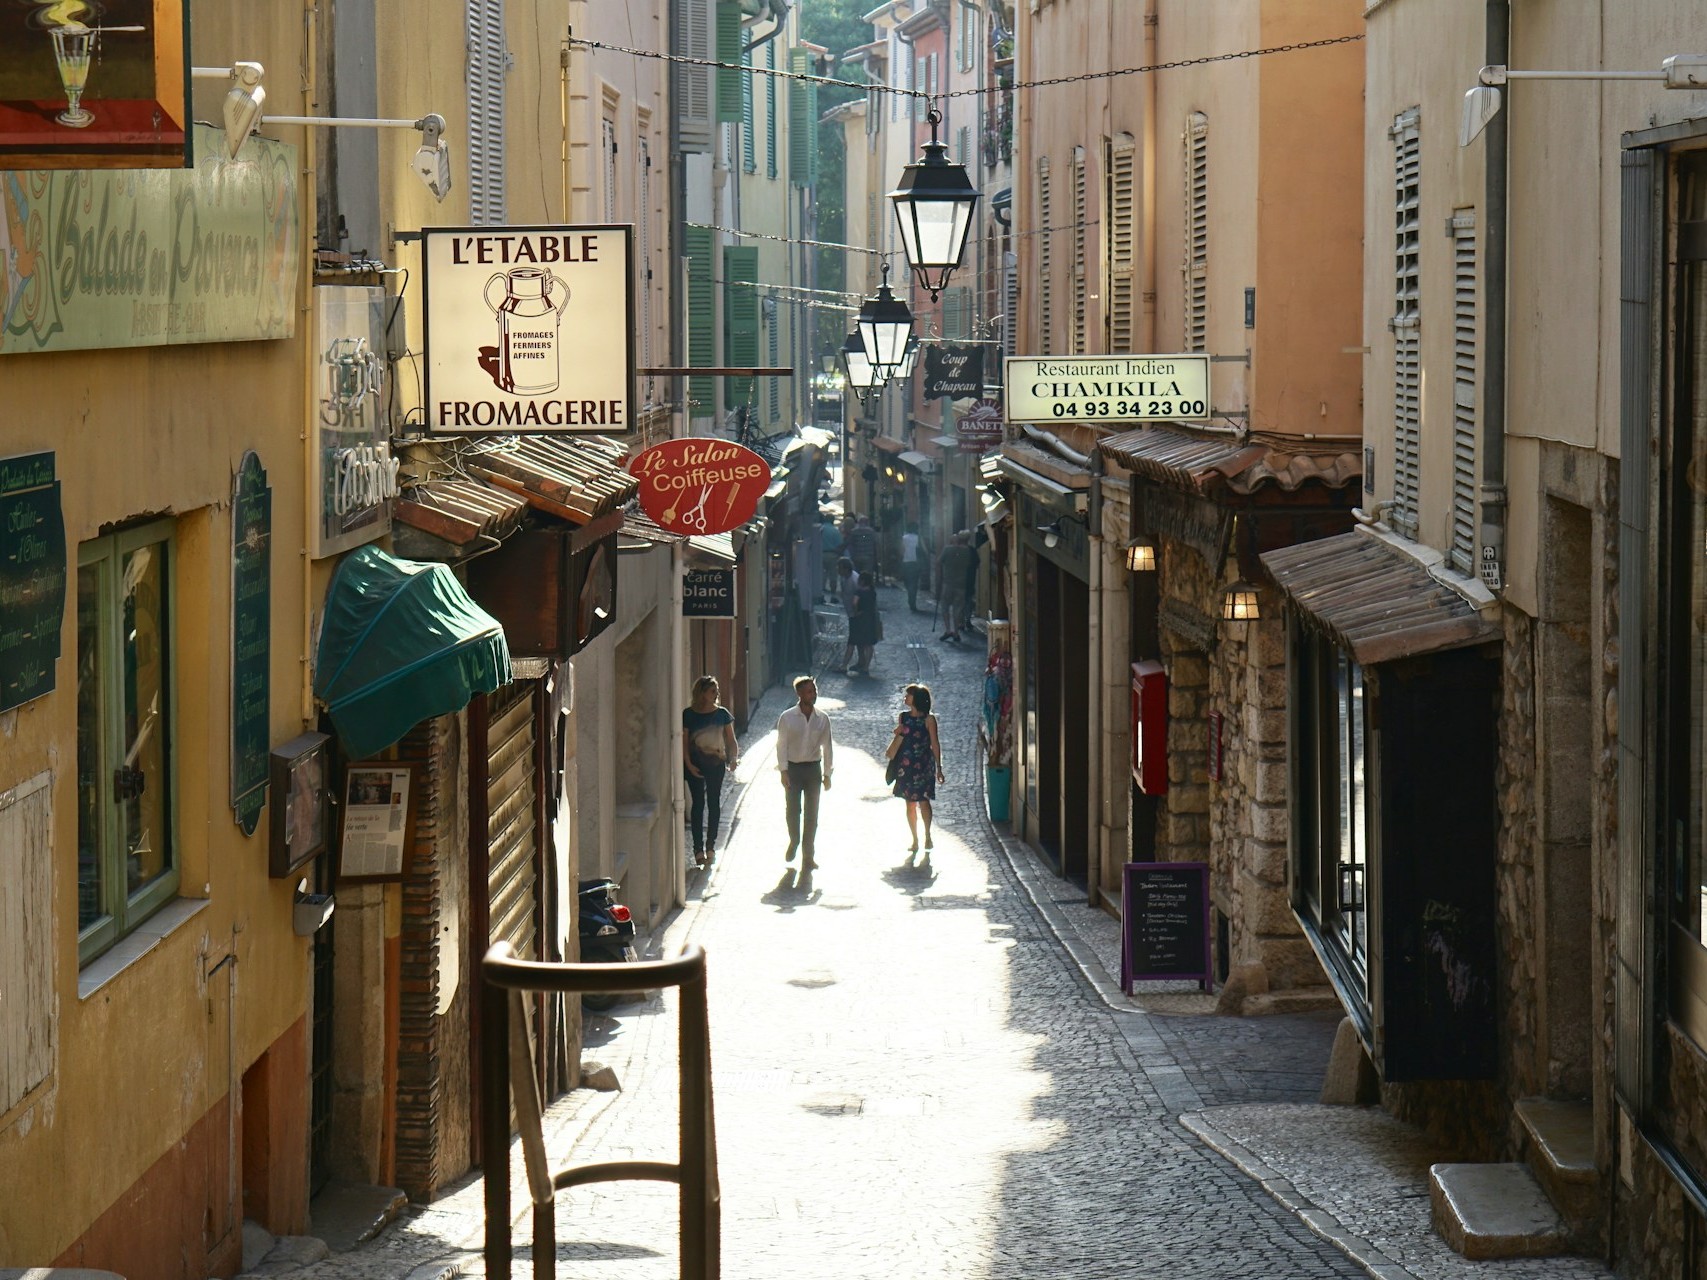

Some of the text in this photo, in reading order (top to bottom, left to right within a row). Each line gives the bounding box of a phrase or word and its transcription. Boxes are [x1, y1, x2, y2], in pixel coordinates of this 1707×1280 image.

[55, 171, 147, 305] Balade
[169, 183, 260, 303] Provence
[452, 235, 599, 264] L'ETABLE
[513, 331, 554, 339] FROMAGES
[513, 341, 552, 349] FERMIERS
[941, 353, 968, 366] Coup
[948, 367, 961, 378] de
[1036, 360, 1175, 377] Restaurant Indien
[933, 380, 977, 393] Chapeau
[1031, 381, 1184, 398] CHAMKILA
[439, 400, 622, 427] FROMAGERIE
[1052, 400, 1205, 417] 04 93 34 23 00
[635, 442, 741, 477] Le Salon
[653, 464, 761, 492] Coiffeuse
[683, 584, 728, 598] blanc
